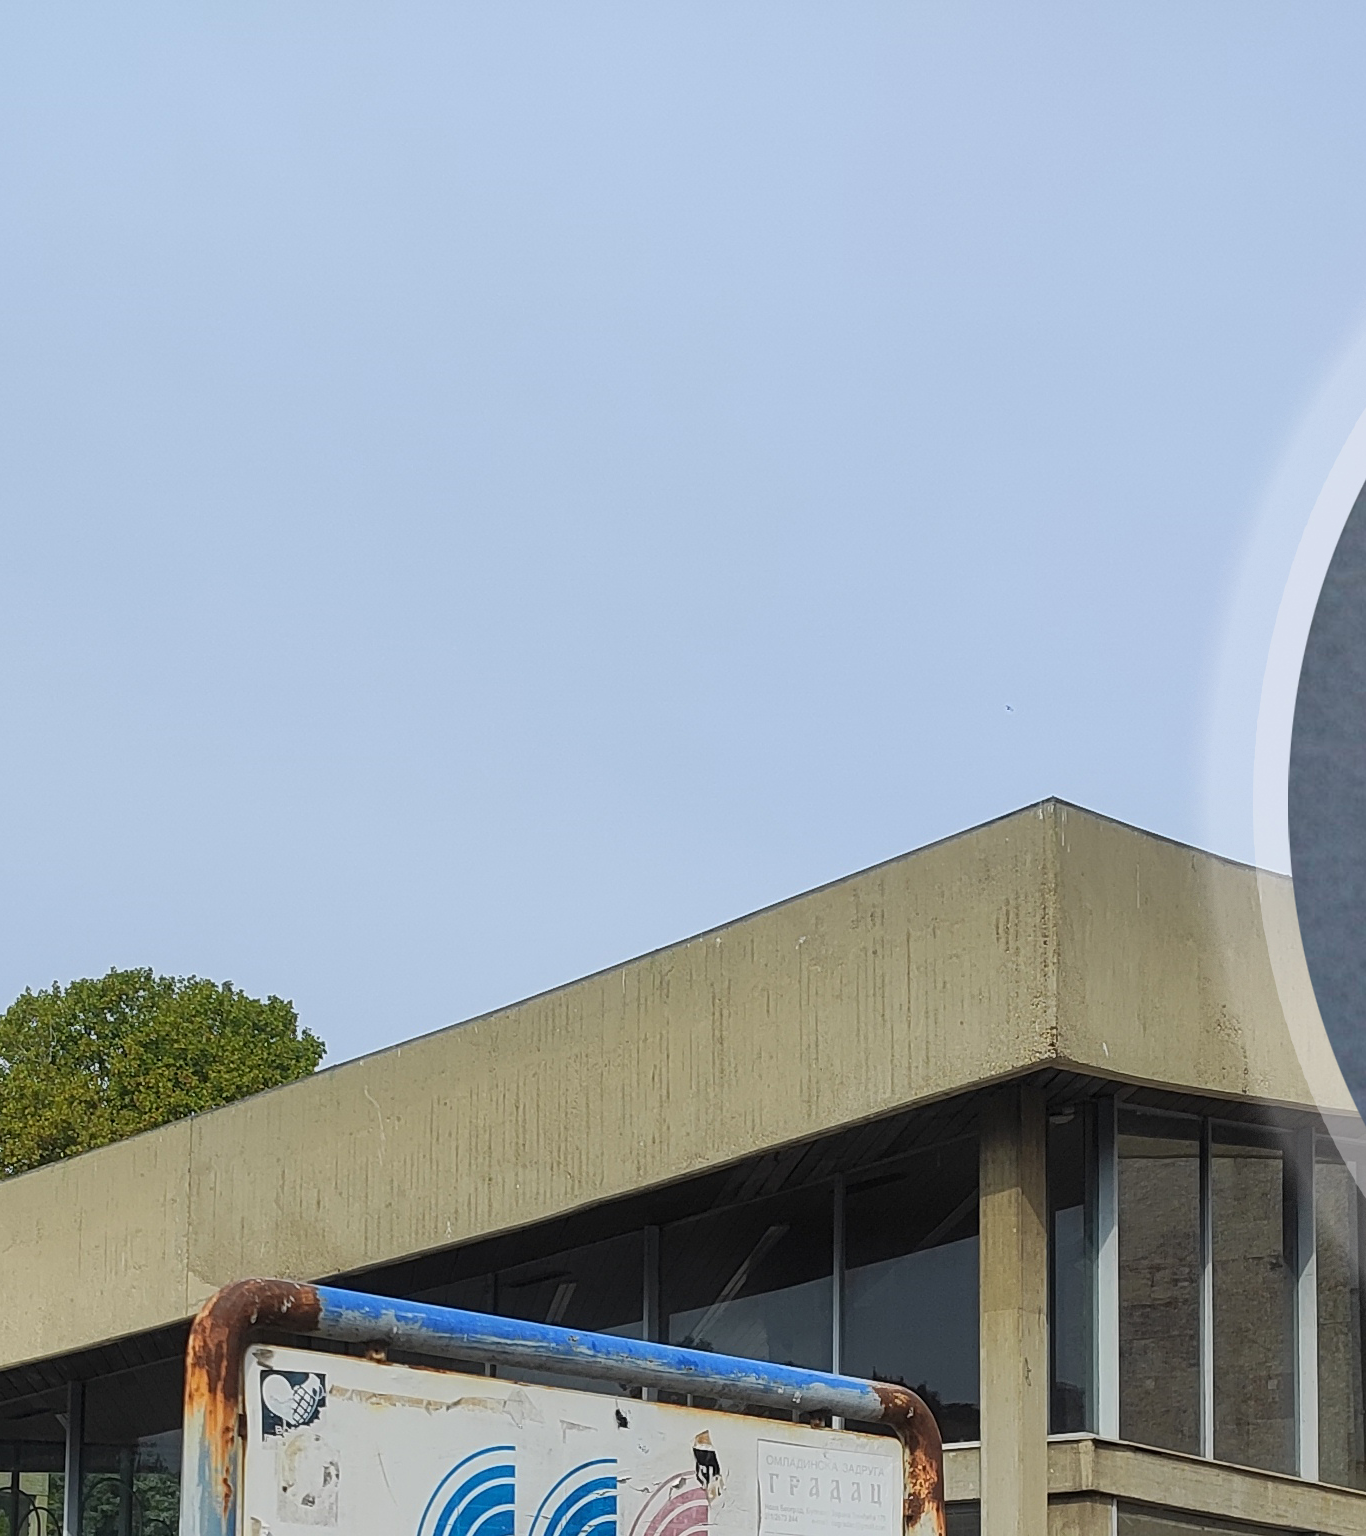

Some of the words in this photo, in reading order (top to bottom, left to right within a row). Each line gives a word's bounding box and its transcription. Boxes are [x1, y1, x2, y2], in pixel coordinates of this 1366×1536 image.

[765, 1454, 839, 1472] ОМЛАДИНСКА
[841, 1462, 886, 1477] ЗАДРУГА
[768, 1472, 883, 1508] ГРАДАЦ
